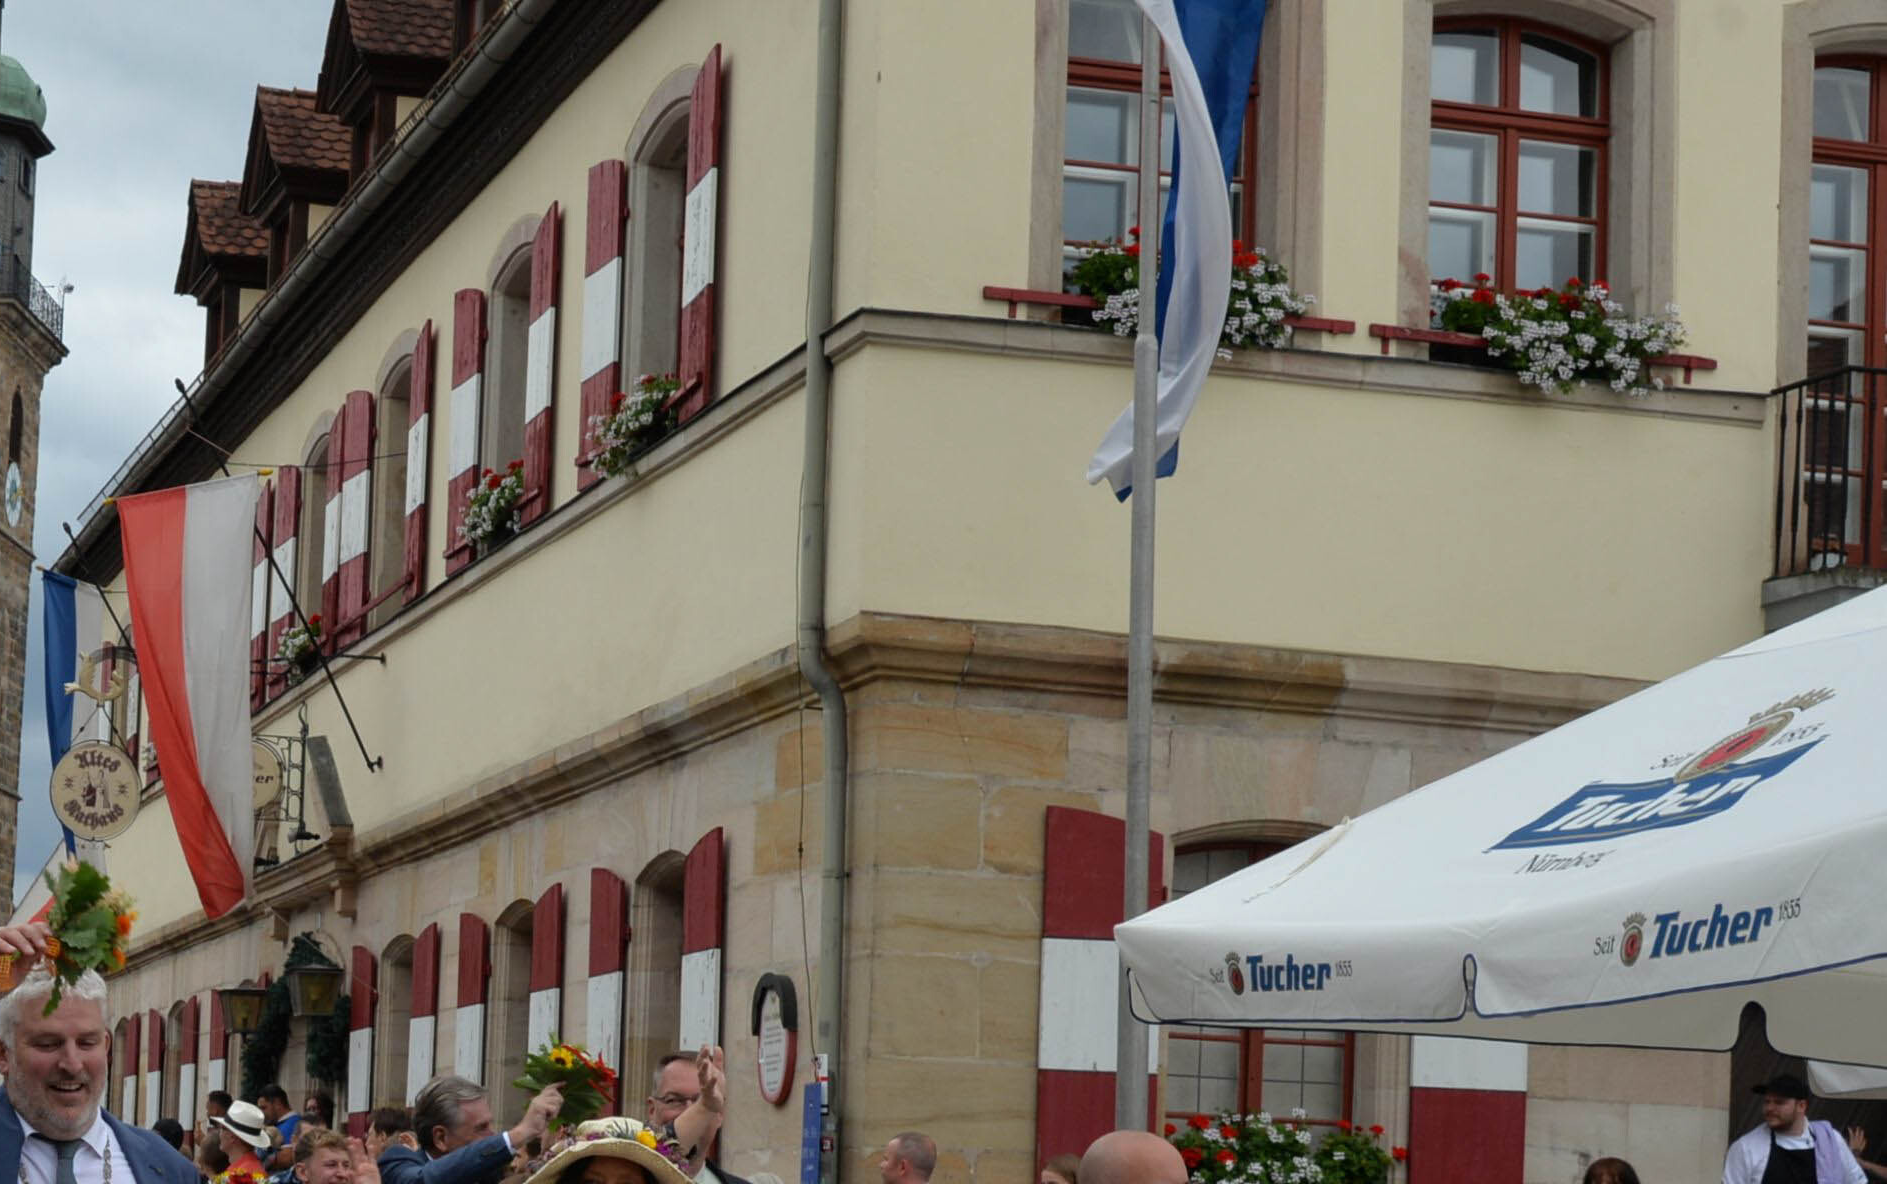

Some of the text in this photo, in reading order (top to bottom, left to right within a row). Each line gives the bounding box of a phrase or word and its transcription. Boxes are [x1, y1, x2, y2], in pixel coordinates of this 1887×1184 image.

[73, 749, 121, 773] Altes
[64, 799, 124, 830] Rathaus
[1534, 775, 1762, 833] Tucher
[1593, 897, 1802, 959] Seit Tucher 1855
[1246, 953, 1332, 992] Tucher
